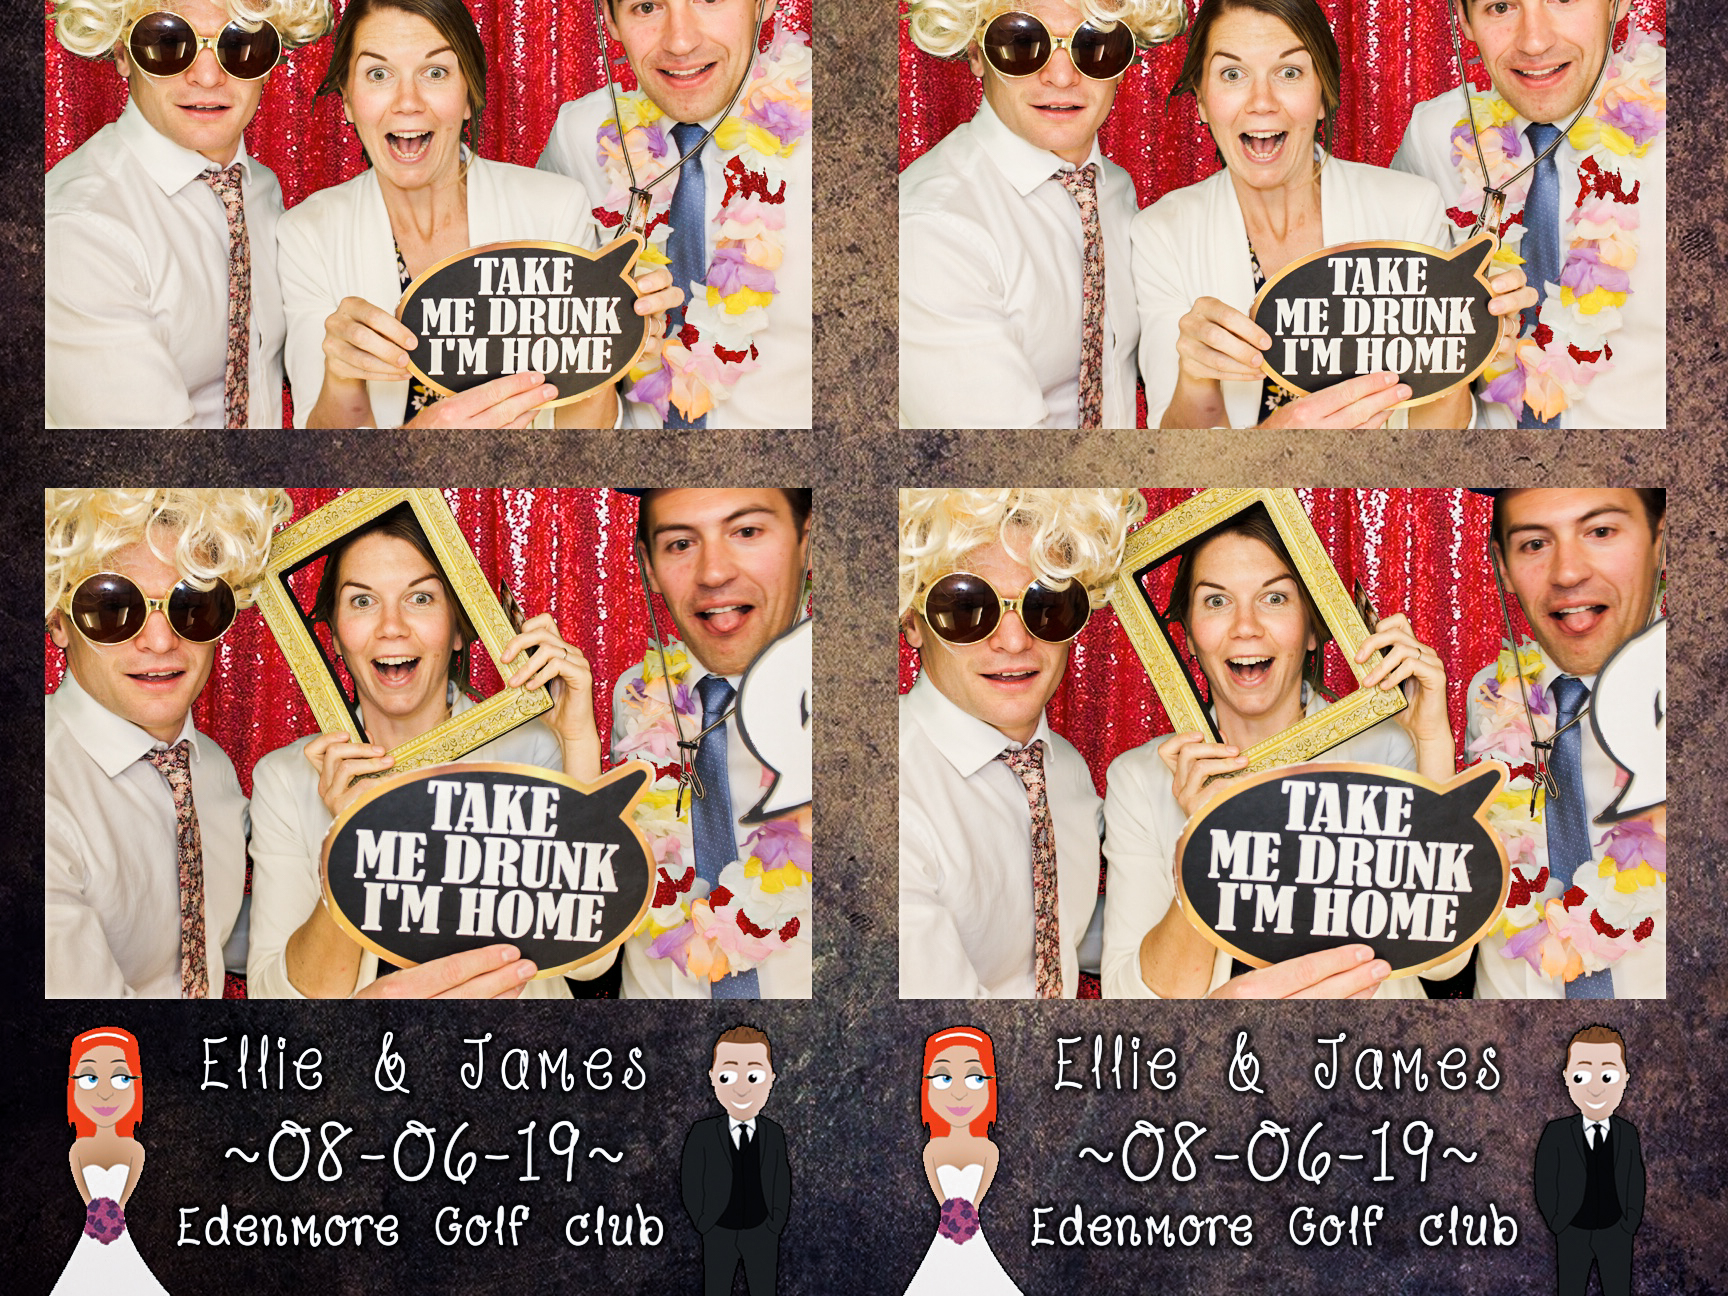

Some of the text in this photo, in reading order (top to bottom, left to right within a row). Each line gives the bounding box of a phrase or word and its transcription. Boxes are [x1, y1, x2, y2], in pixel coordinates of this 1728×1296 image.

[474, 257, 574, 296] TAKE
[1328, 257, 1428, 296] TAKE
[421, 297, 623, 336] ME DRUNK
[1275, 297, 1477, 336] ME DRUNK
[428, 337, 613, 376] I'M HOME
[1282, 337, 1467, 376] I'M HOME
[427, 780, 561, 837] TAKE
[1281, 780, 1415, 837] TAKE
[353, 829, 620, 892] ME DRUNK
[1207, 829, 1474, 892] ME DRUNK
[360, 882, 606, 943] I'M HOME
[1214, 882, 1460, 943] I'M HOME
